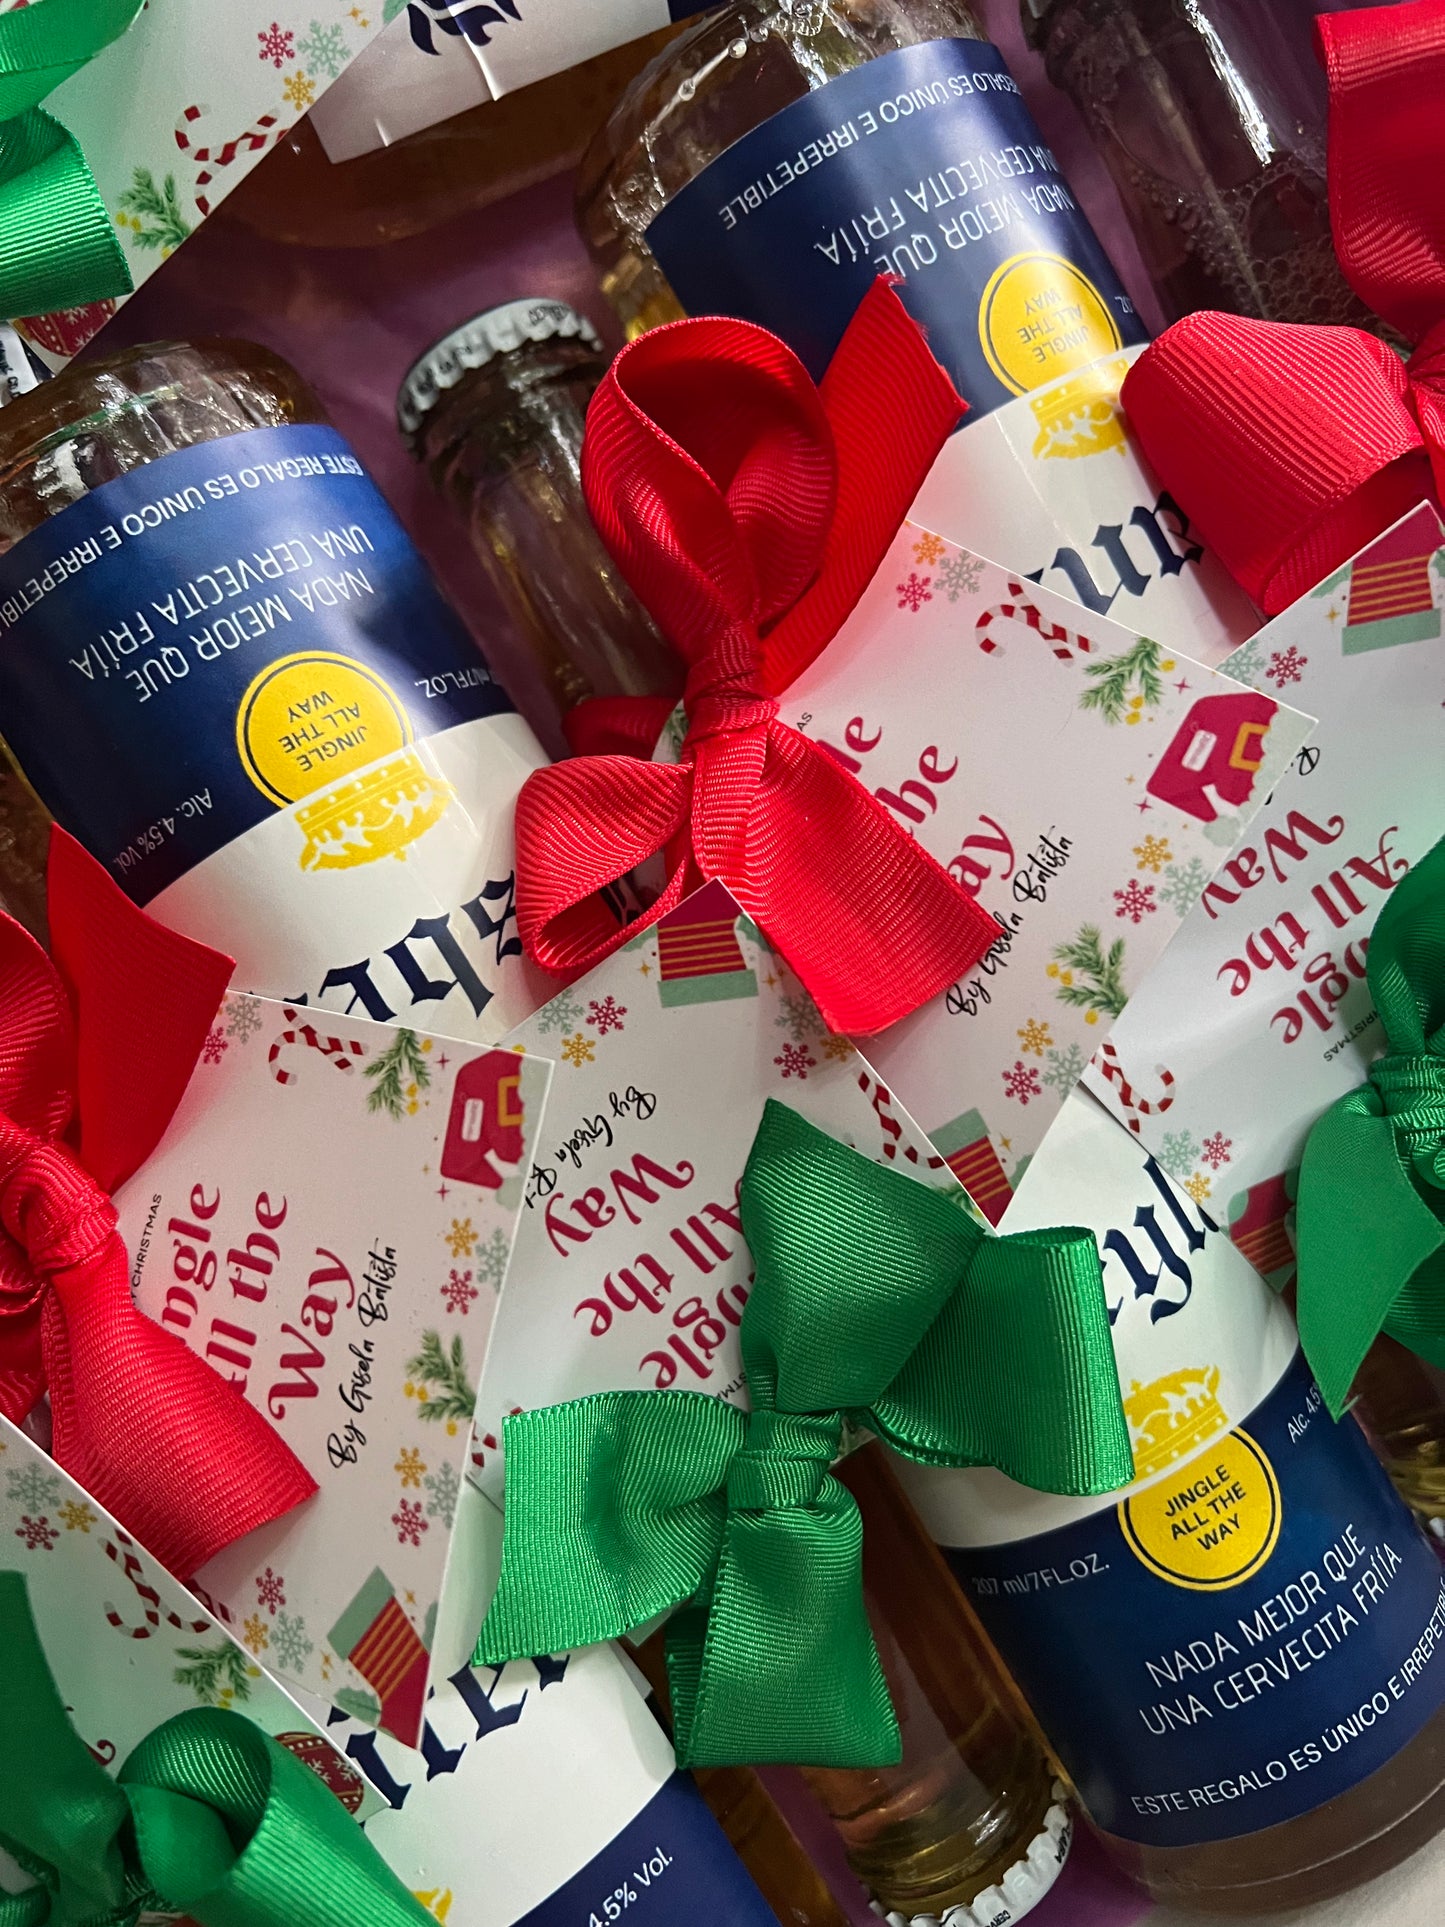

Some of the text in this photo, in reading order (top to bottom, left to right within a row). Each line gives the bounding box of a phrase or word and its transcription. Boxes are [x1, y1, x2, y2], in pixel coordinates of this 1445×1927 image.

[880, 82, 948, 115] ÚNICO
[948, 75, 973, 96] ES
[858, 112, 876, 135] E
[719, 125, 858, 230] IRREPETIBLE
[906, 146, 1033, 214] CERVECITA
[1028, 184, 1075, 211] NADA
[940, 194, 1024, 250] MEJOR
[1020, 305, 1083, 344] ALL THE
[1024, 288, 1061, 312] WAY
[1034, 328, 1089, 363] JINGLE
[210, 476, 238, 499] ES
[246, 460, 325, 487] REGALO
[329, 456, 363, 476] ESTE
[122, 486, 207, 534] ÚNICO
[101, 529, 122, 549] E
[323, 526, 374, 556] UNA
[157, 536, 312, 625] CERVECITA
[127, 569, 374, 702] NADA MEJOR QUE
[278, 702, 360, 753] ALL THE
[288, 691, 334, 721] WAY
[300, 727, 368, 771] JINGLE
[175, 788, 212, 818] Alc.
[875, 746, 958, 839] he
[137, 814, 175, 856] 4.5%
[947, 815, 1015, 896] ay
[946, 978, 991, 1016] By
[1013, 826, 1073, 902] Batista
[1217, 826, 1409, 996] All the
[1271, 937, 1369, 1043] ngle
[1323, 1010, 1380, 1061] HRISTMAS
[556, 1086, 656, 1168] By Gisela
[545, 1153, 695, 1257] Way
[132, 1194, 162, 1287] CHRISTMAS
[162, 1183, 220, 1344] ngle
[227, 1191, 287, 1303] the
[574, 1254, 674, 1337] the
[268, 1248, 355, 1419] Way
[327, 1238, 397, 1468] By Gisela Batista
[639, 1272, 756, 1389] ngle
[1287, 1414, 1309, 1444] Alc.
[1165, 1465, 1231, 1517] JINGLE
[1170, 1483, 1246, 1540] ALL THE
[1198, 1514, 1242, 1551] WAY
[973, 1576, 1000, 1594] 207
[1146, 1524, 1366, 1688] NADA MEJOR QUE
[1139, 1694, 1213, 1735] UNA
[1214, 1613, 1358, 1710] CERVECITA
[1132, 1794, 1190, 1814] ESTE
[1189, 1761, 1287, 1807] REGALO
[1289, 1743, 1322, 1771] ES
[1322, 1692, 1389, 1753] ÚNICO
[1388, 1675, 1404, 1700] E
[634, 1847, 675, 1890] Vol.
